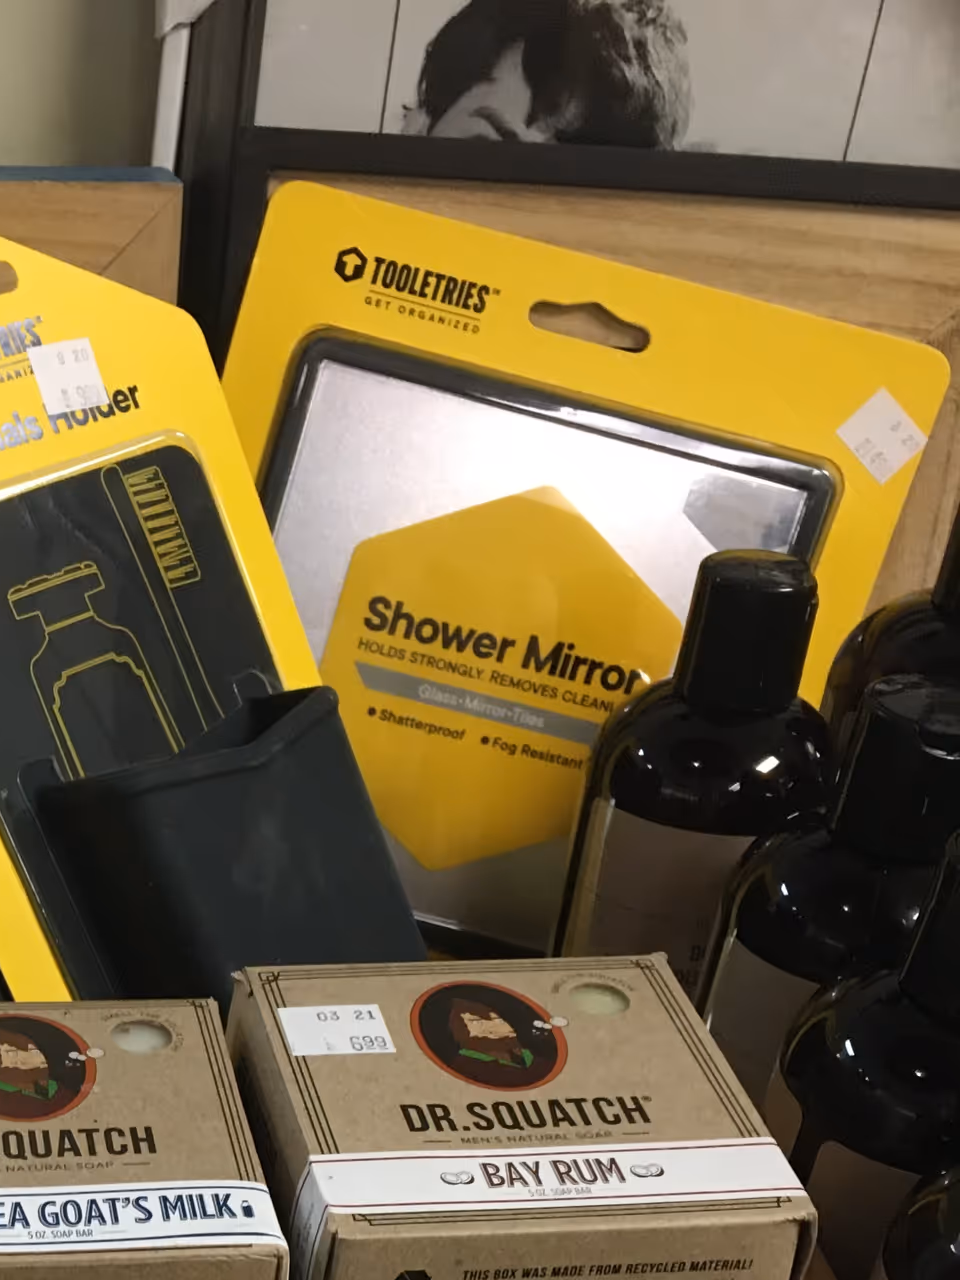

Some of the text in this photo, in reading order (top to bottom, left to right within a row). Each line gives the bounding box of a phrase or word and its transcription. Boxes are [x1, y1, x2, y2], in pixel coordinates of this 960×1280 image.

[371, 256, 490, 314] TOOLETRIES
[364, 296, 481, 335] GET ORGANIZED
[363, 596, 642, 695] Shower Mirror
[358, 637, 406, 661] HOLDS
[490, 669, 559, 700] REMOVES
[379, 709, 466, 740] Shatterproof
[492, 737, 584, 770] Fog Resistant
[316, 1010, 376, 1022] 03 21
[349, 1035, 389, 1051] 699
[400, 1096, 652, 1132] DR.SQUATCH
[506, 1133, 569, 1144] NATURAL
[6, 1162, 67, 1173] NATURAL
[76, 1161, 115, 1170] SOAP
[479, 1157, 626, 1189] BAY RUM
[38, 1195, 154, 1227] GOAT'S
[158, 1192, 238, 1222] MILK
[51, 1229, 74, 1239] SOAP
[75, 1228, 94, 1237] BAR
[462, 1259, 753, 1280] THIS BOX WAS MADE FROM RECYCLED MATERIAL!
